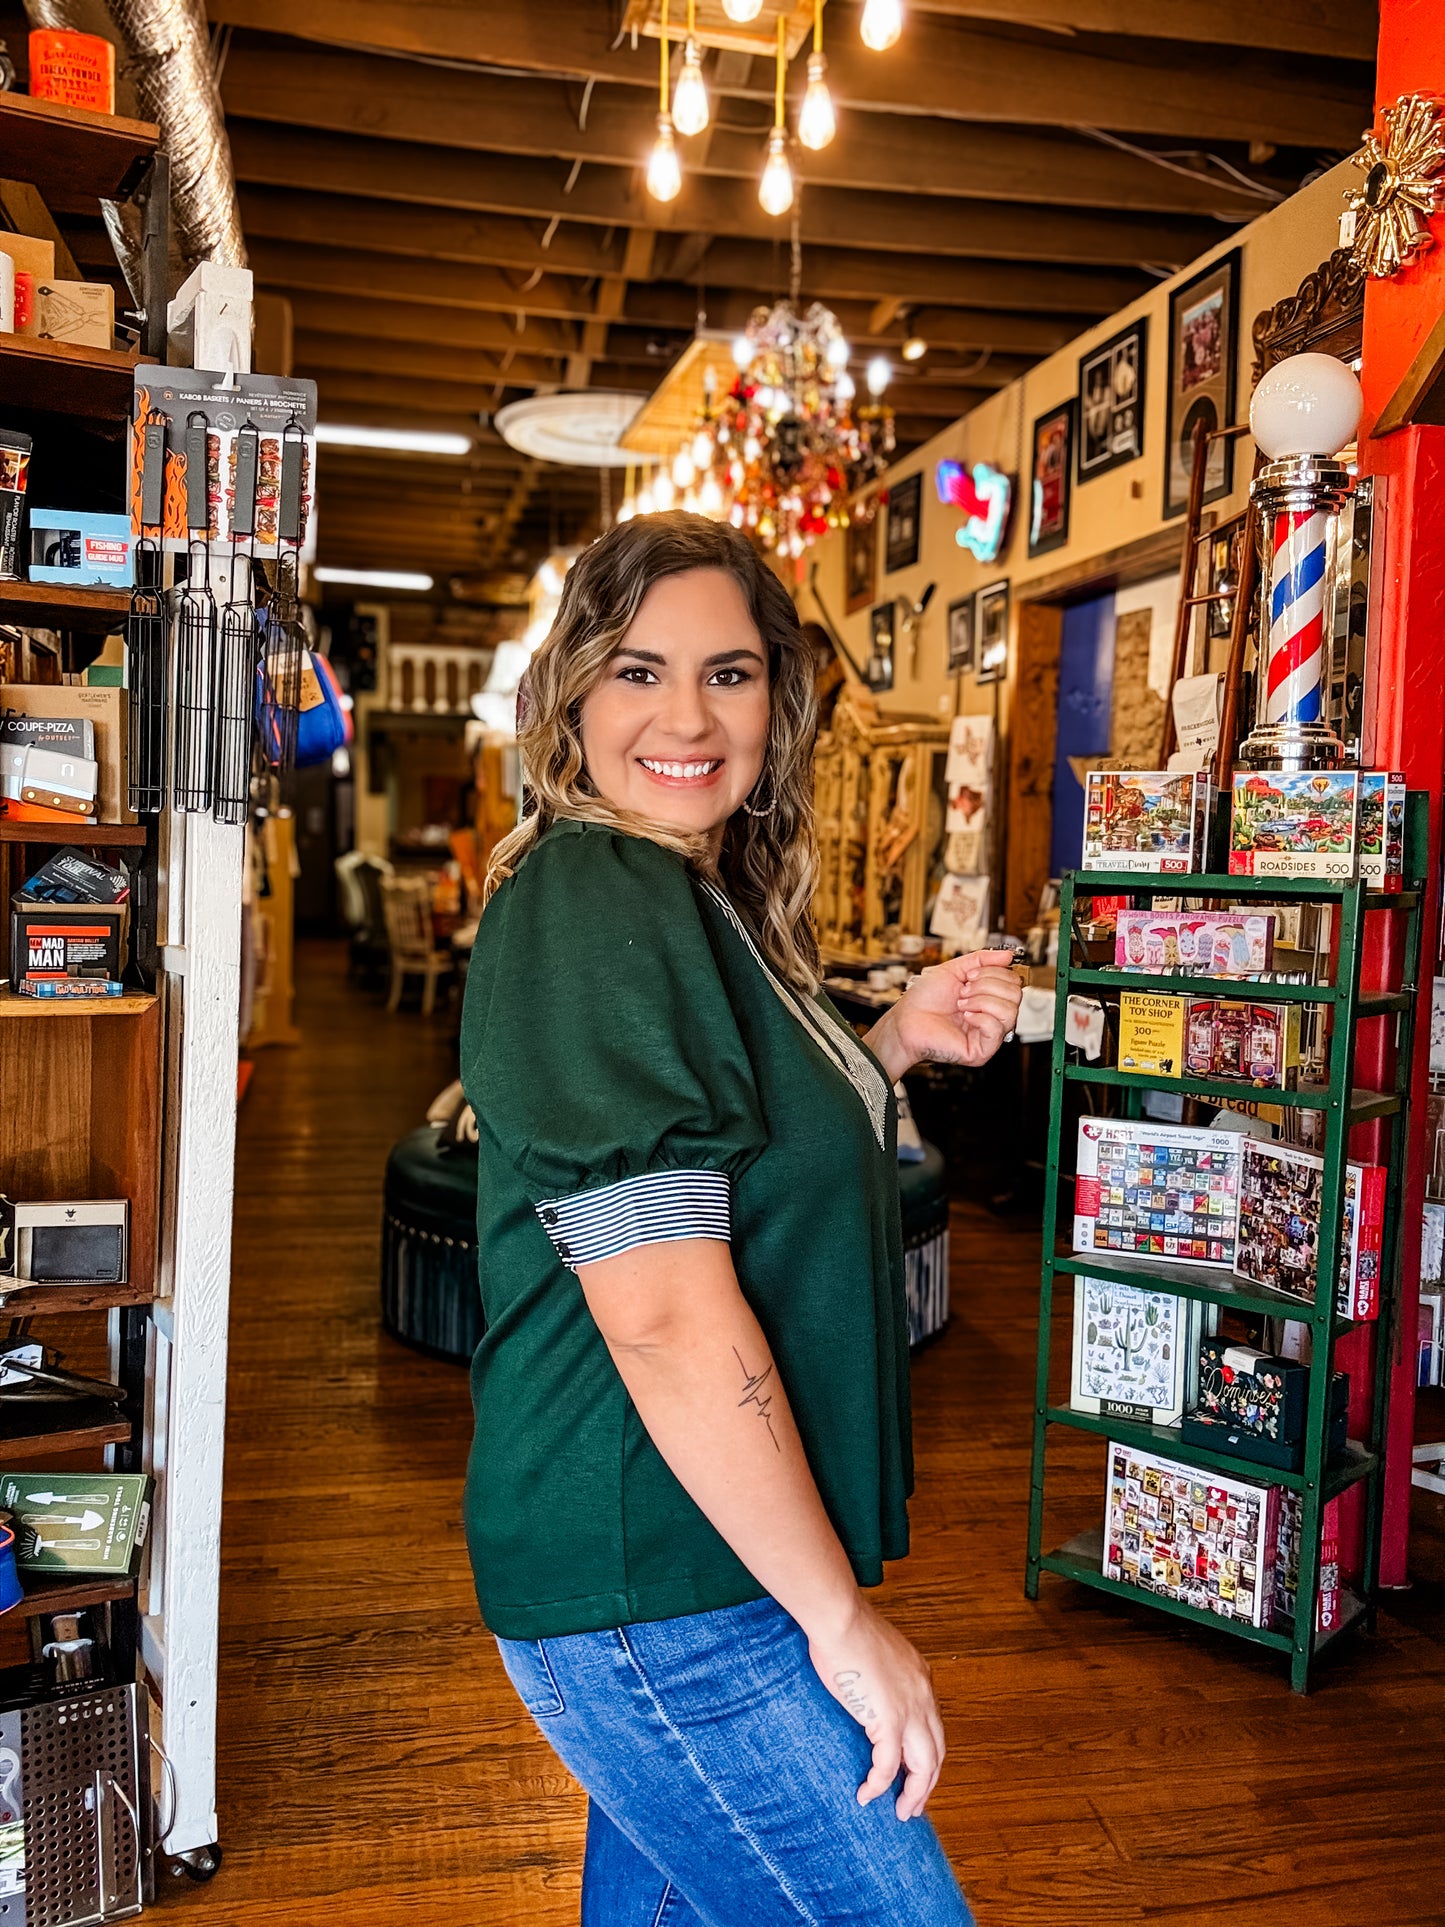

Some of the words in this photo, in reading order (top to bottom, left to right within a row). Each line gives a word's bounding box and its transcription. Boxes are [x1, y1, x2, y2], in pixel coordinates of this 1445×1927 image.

[72, 67, 101, 82] POWDER
[179, 392, 202, 401] KABOB
[203, 394, 230, 404] BASKETS
[236, 398, 262, 407] PANIERS
[270, 400, 306, 410] BROCHETTE
[90, 541, 123, 551] FISHING
[87, 552, 108, 562] GUIDE
[108, 554, 124, 563] MUG
[8, 721, 75, 733] COUPE-PIZZA
[1391, 774, 1403, 783] 500
[65, 855, 106, 881] SURVIVAL
[1097, 861, 1128, 870] TRAVEL
[1128, 860, 1150, 870] Diary
[1165, 860, 1183, 870] 500
[1260, 861, 1316, 872] ROADSIDES
[1326, 863, 1349, 874] 500
[1360, 864, 1381, 875] 500
[1150, 912, 1174, 920] BOOTS
[1175, 913, 1217, 923] PANORAMIC
[1218, 915, 1244, 923] PUZZLE
[42, 937, 65, 949] MAD
[28, 949, 64, 967] MAN
[1123, 995, 1141, 1006] THE
[1142, 997, 1180, 1009] CORNER
[1130, 1006, 1147, 1016] TOY
[1148, 1009, 1173, 1019] SHOP
[1134, 1026, 1151, 1036] 300
[1211, 1137, 1230, 1146] 1000
[1106, 1402, 1133, 1415] 1000
[114, 1485, 124, 1507] TOOLS
[106, 1507, 118, 1544] GARDENING
[103, 1545, 111, 1560] MINI
